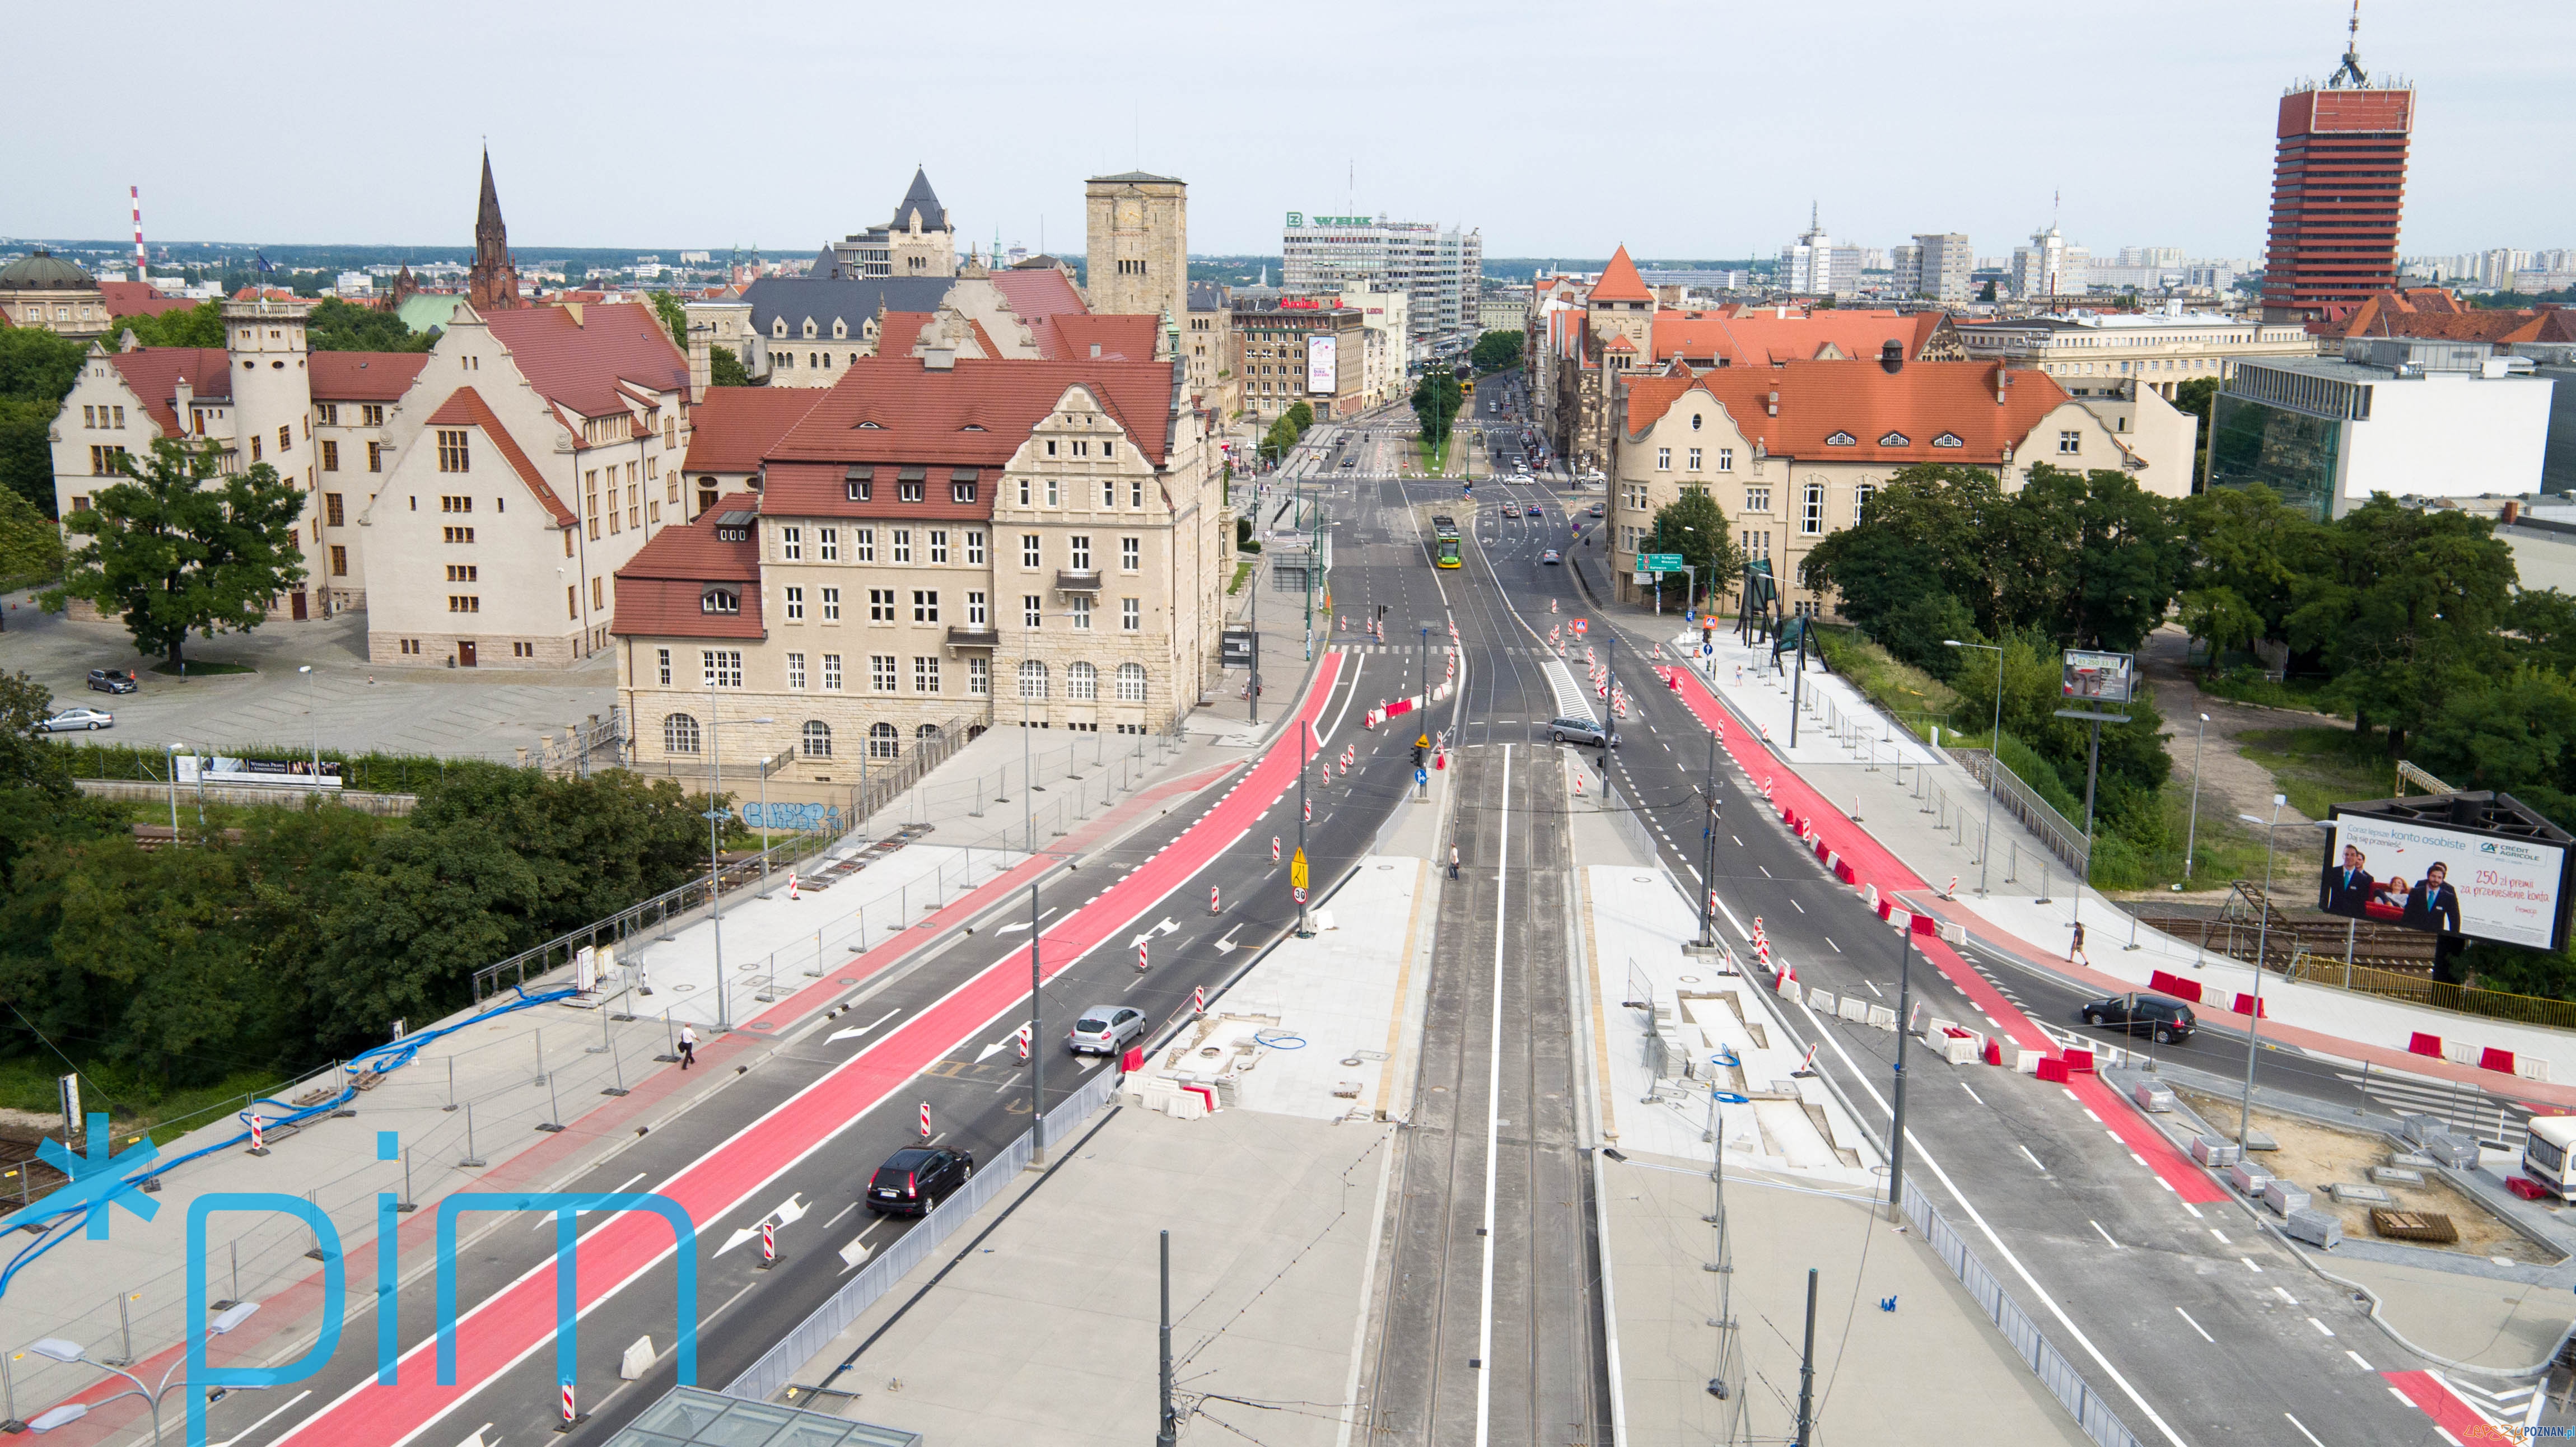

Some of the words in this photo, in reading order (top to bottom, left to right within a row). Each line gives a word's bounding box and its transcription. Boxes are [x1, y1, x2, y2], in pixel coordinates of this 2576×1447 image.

[1281, 297, 1319, 309] Amica
[2347, 833, 2358, 842] Daj
[2348, 824, 2367, 834] Coraz
[2391, 829, 2420, 843] konto
[2422, 835, 2466, 850] osobiste
[2499, 851, 2540, 861] AGRICOLE
[2476, 870, 2498, 885] 250
[2509, 878, 2534, 889] premii
[1295, 890, 1305, 899] 30
[2460, 885, 2471, 894] za
[2527, 890, 2550, 903] konta
